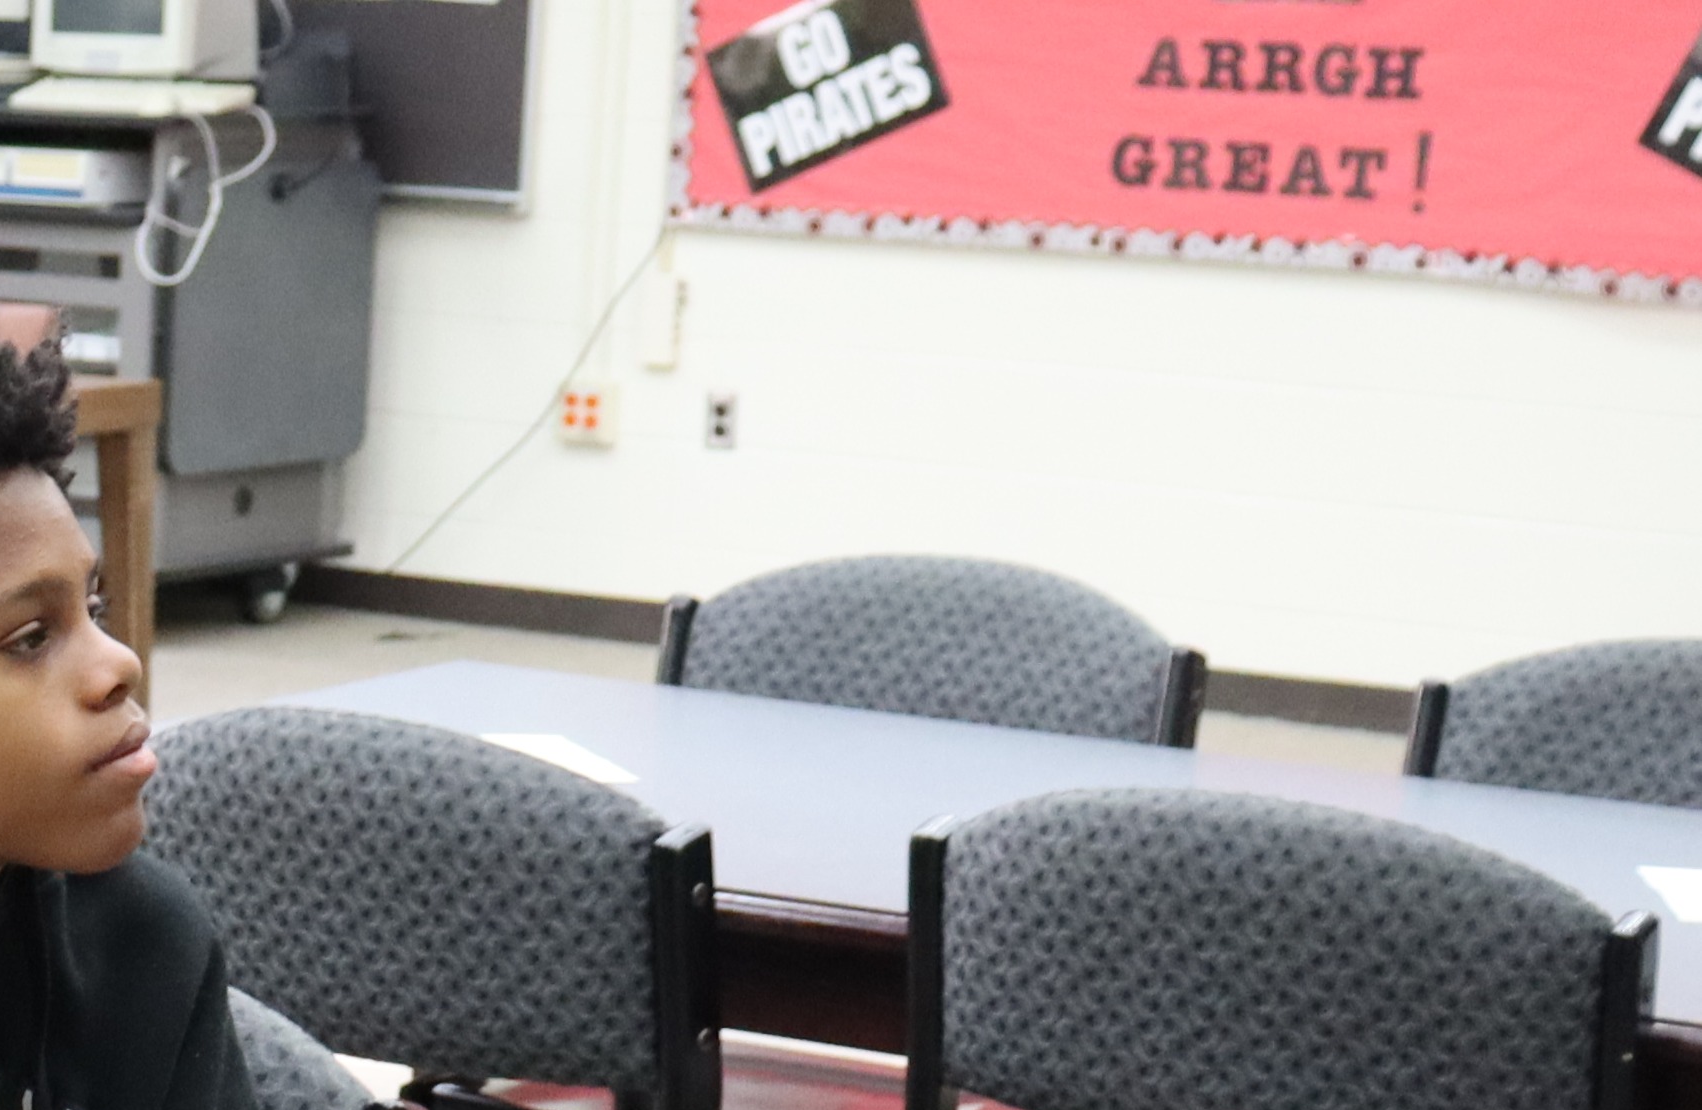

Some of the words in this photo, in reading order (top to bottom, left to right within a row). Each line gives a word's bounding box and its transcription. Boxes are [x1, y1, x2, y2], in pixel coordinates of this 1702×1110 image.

[777, 8, 851, 89] GO
[1136, 36, 1424, 99] ARRGH
[737, 42, 932, 179] PIRATES
